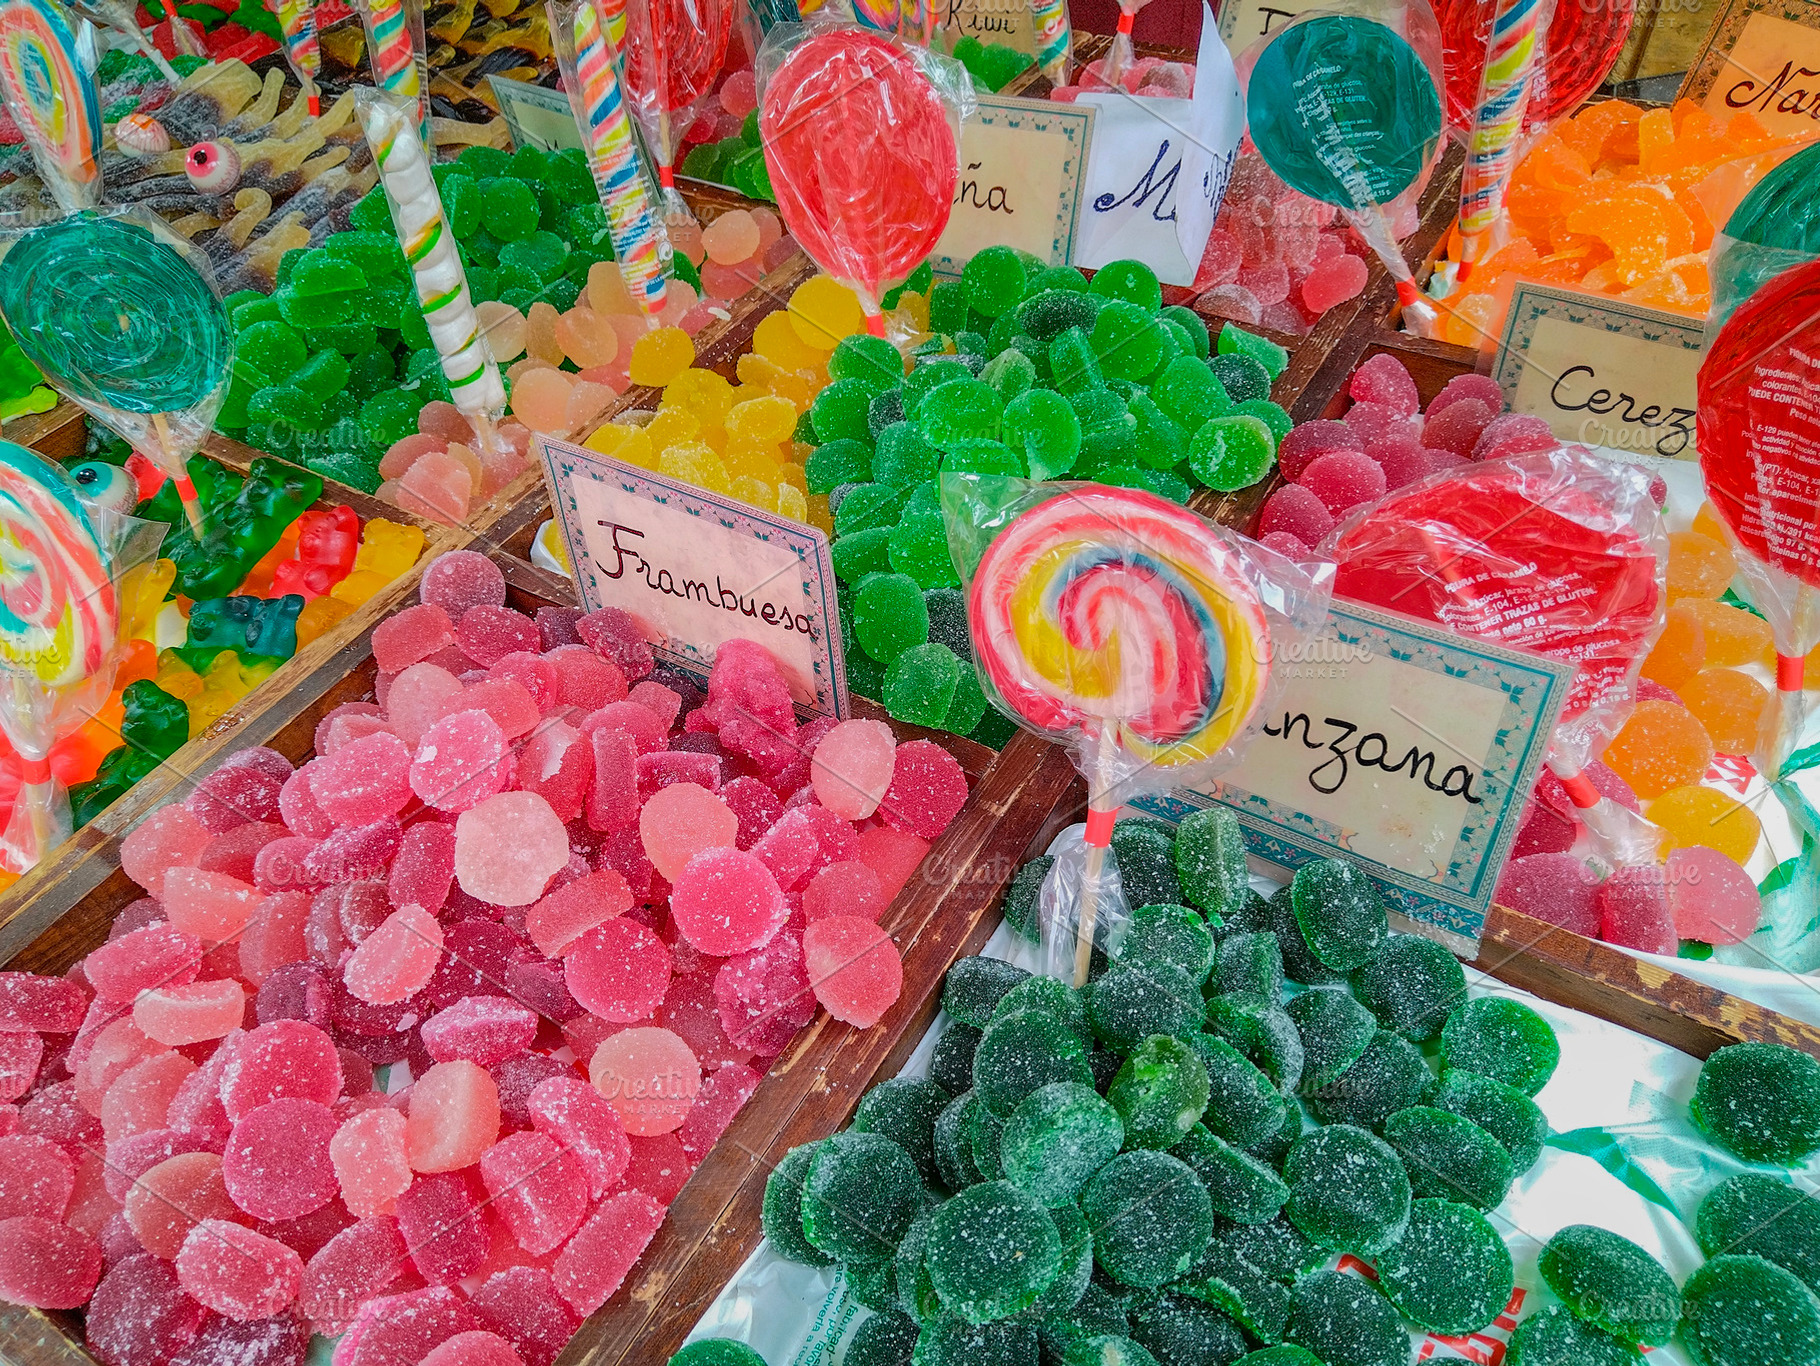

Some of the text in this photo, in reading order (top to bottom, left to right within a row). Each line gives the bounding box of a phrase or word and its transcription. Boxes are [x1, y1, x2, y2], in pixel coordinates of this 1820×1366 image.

[954, 162, 1014, 214] ña
[1773, 393, 1814, 412] CONTENER
[1777, 477, 1801, 492] E-104,
[595, 520, 818, 641] Frambuesa
[1484, 599, 1513, 616] E-104,
[1503, 602, 1540, 620] TRAZAS
[1542, 597, 1556, 608] DE
[834, 1260, 844, 1283] are
[812, 1286, 839, 1332] volverla
